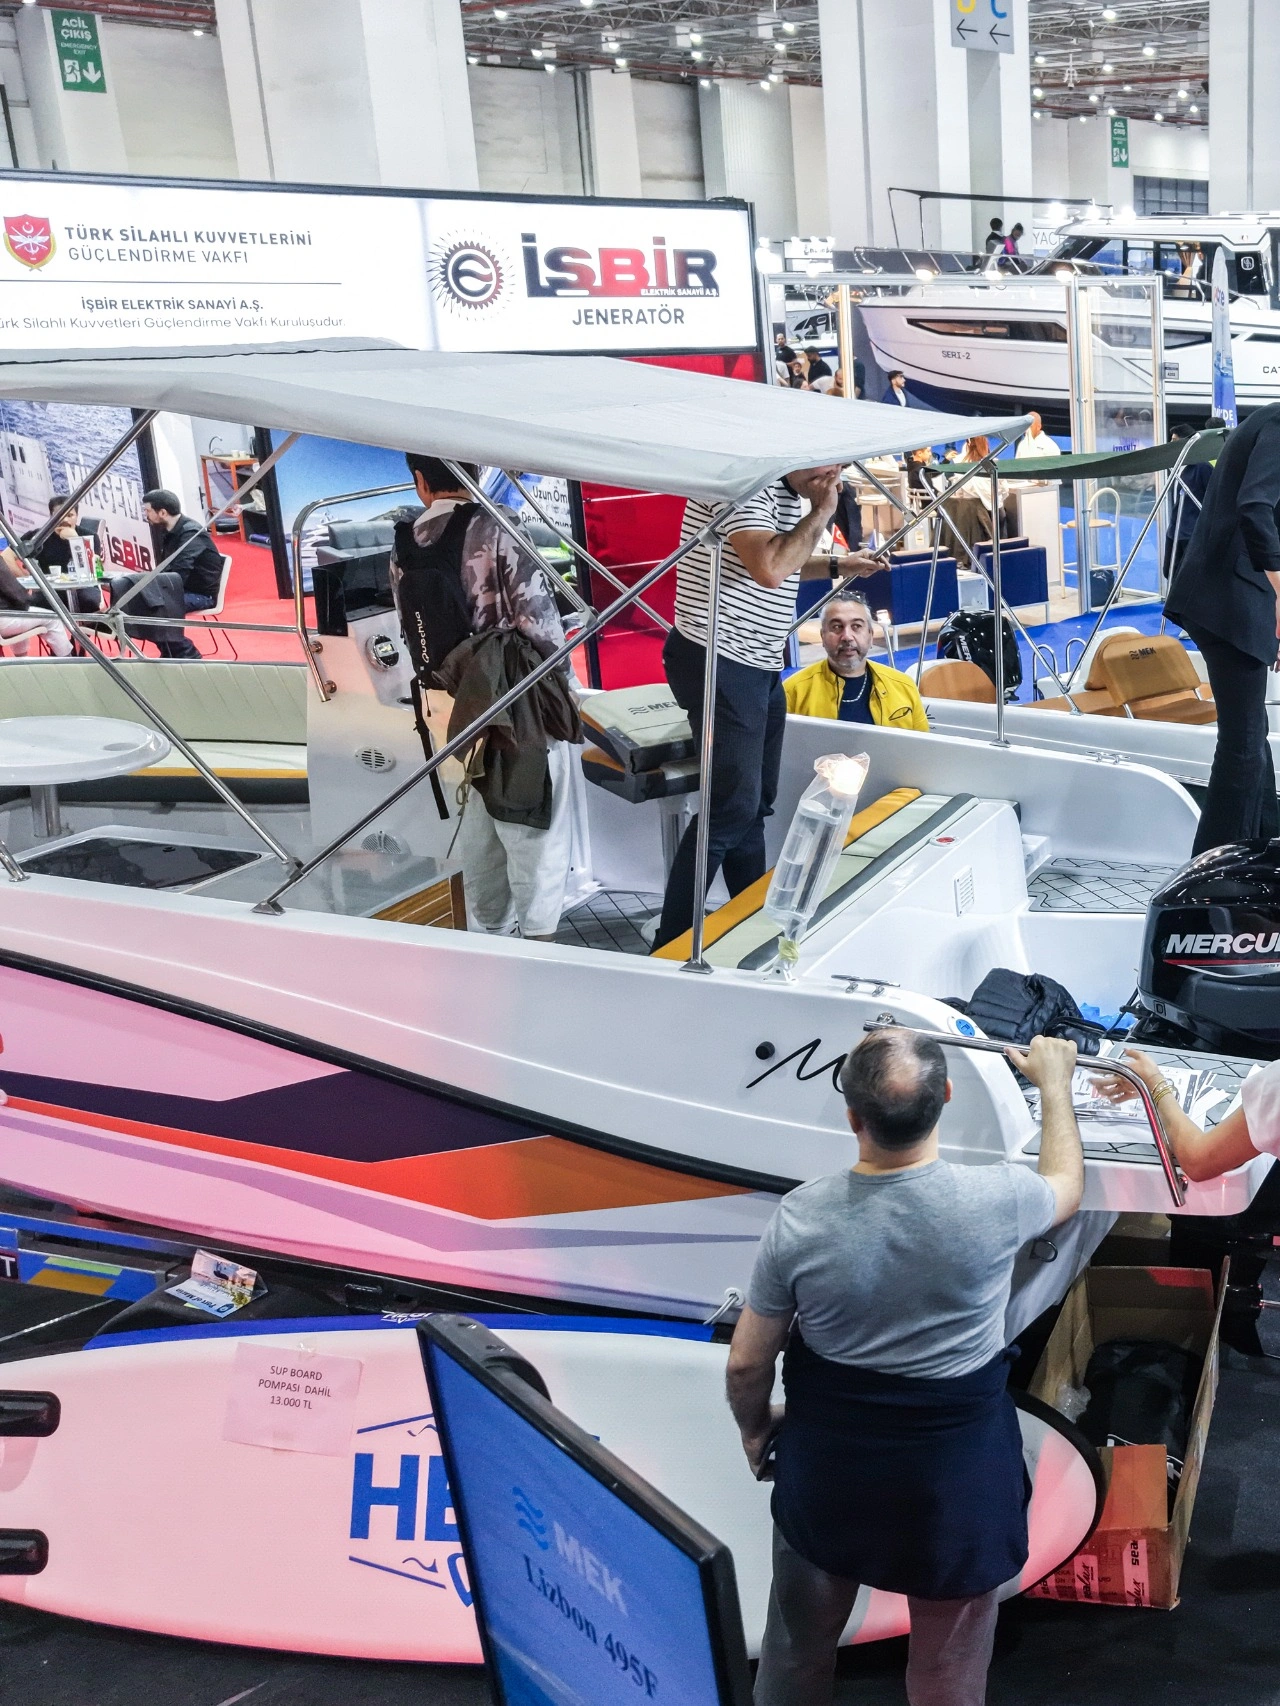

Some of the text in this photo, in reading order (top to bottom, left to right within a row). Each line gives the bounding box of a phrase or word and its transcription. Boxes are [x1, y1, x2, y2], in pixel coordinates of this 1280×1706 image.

[61, 16, 88, 29] ACİL
[60, 28, 92, 42] ÇIKIŞ
[64, 226, 312, 246] TÜRK SİLAHLI KUVVETLERİNİ
[68, 247, 249, 263] GÜÇLENDİRME VAKFI
[81, 296, 264, 312] İŞBİR ELEKTRİK SANAYİ A.Ş.
[572, 304, 685, 326] JENERATÖR
[0, 318, 20, 328] ürk
[70, 317, 141, 329] Kuvvetleri
[144, 317, 232, 331] Güçlendirme
[532, 485, 553, 501] Uzun
[415, 611, 430, 664] Quechua
[959, 635, 972, 661] MER
[1139, 646, 1157, 660] MEK
[270, 1365, 323, 1381] SUP BOARD
[258, 1378, 331, 1398] POMPASI DAHİL
[270, 1395, 313, 1409] 13.000 TL
[552, 1520, 629, 1618] MEK
[522, 1553, 658, 1699] Lizbon 495F
